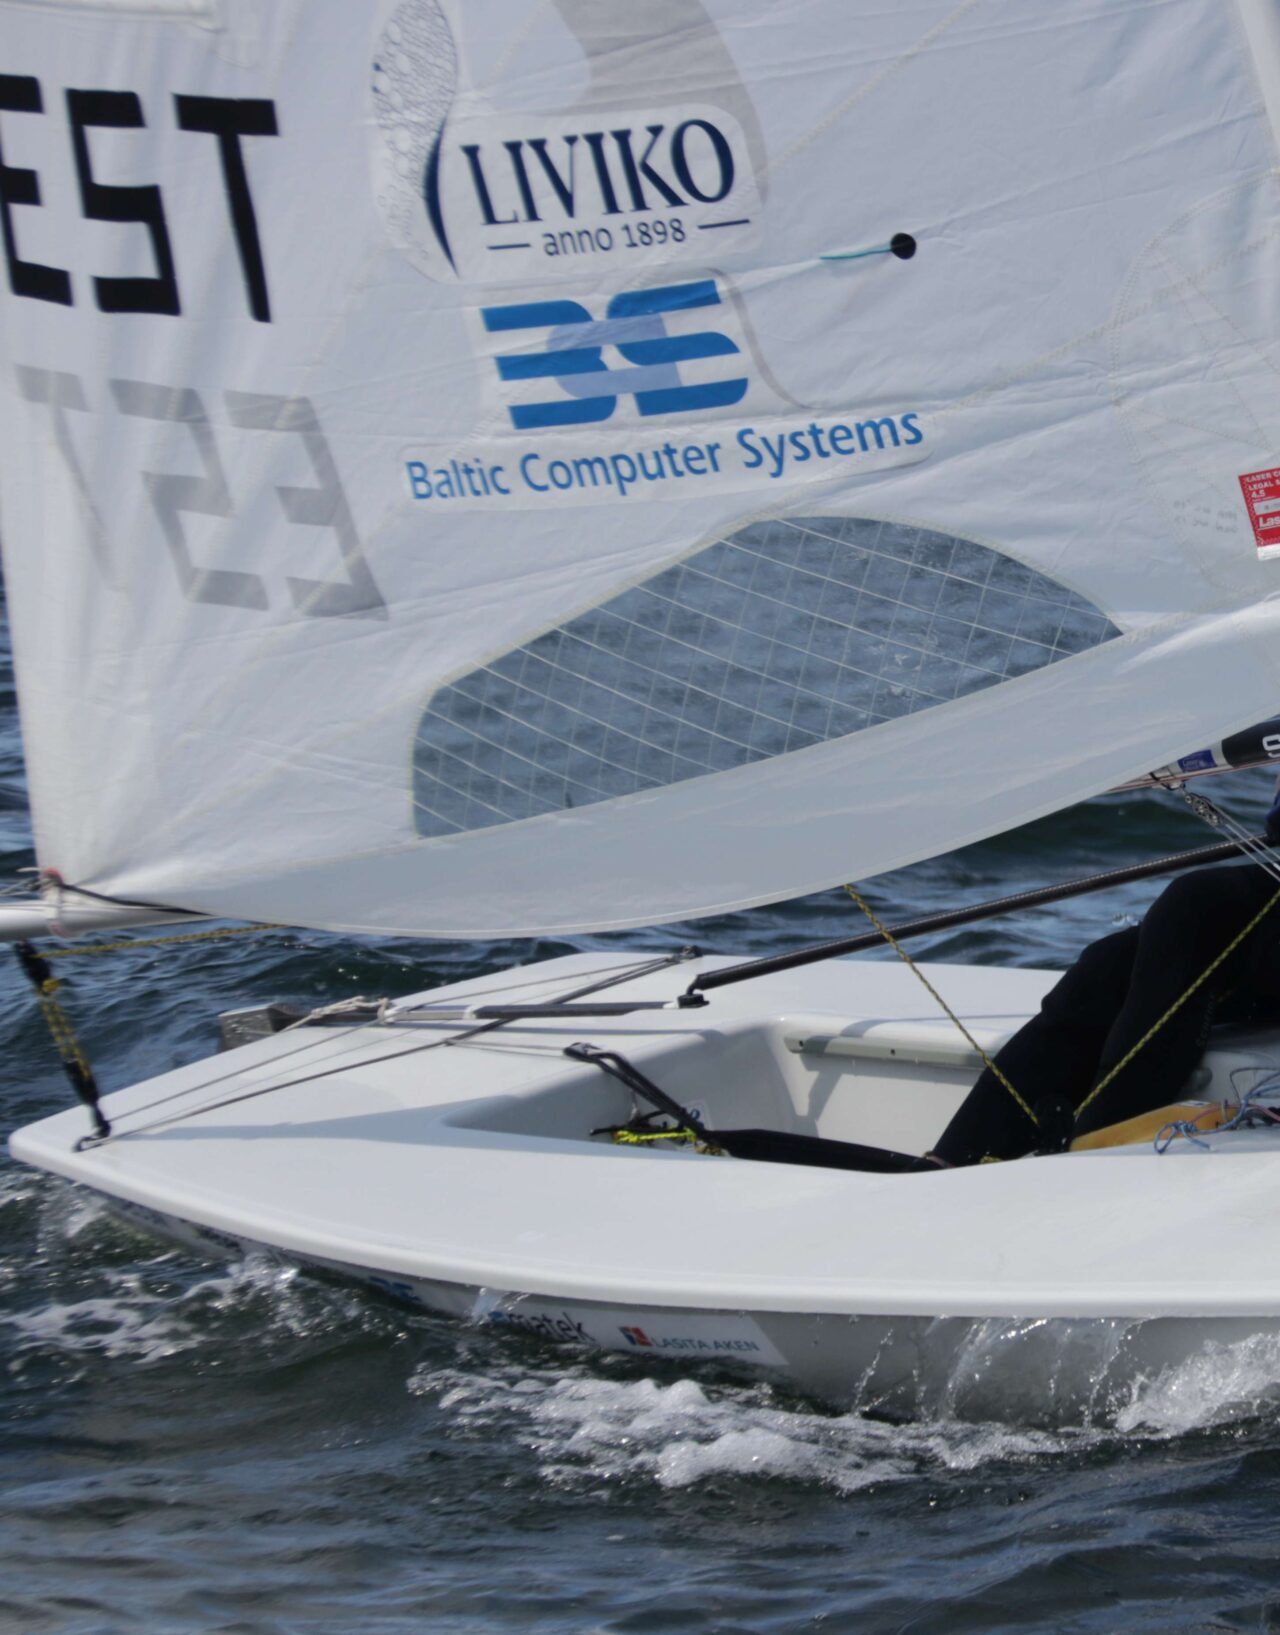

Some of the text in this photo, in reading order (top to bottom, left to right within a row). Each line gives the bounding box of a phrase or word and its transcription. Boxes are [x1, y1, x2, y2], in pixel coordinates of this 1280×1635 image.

[0, 73, 280, 323] EST
[461, 118, 735, 226] LIVIKO
[542, 218, 687, 257] anno 1898
[406, 412, 924, 500] Baltic Computer Systems
[1248, 479, 1274, 491] LEGAL
[650, 1335, 761, 1351] LASITA AKEN
